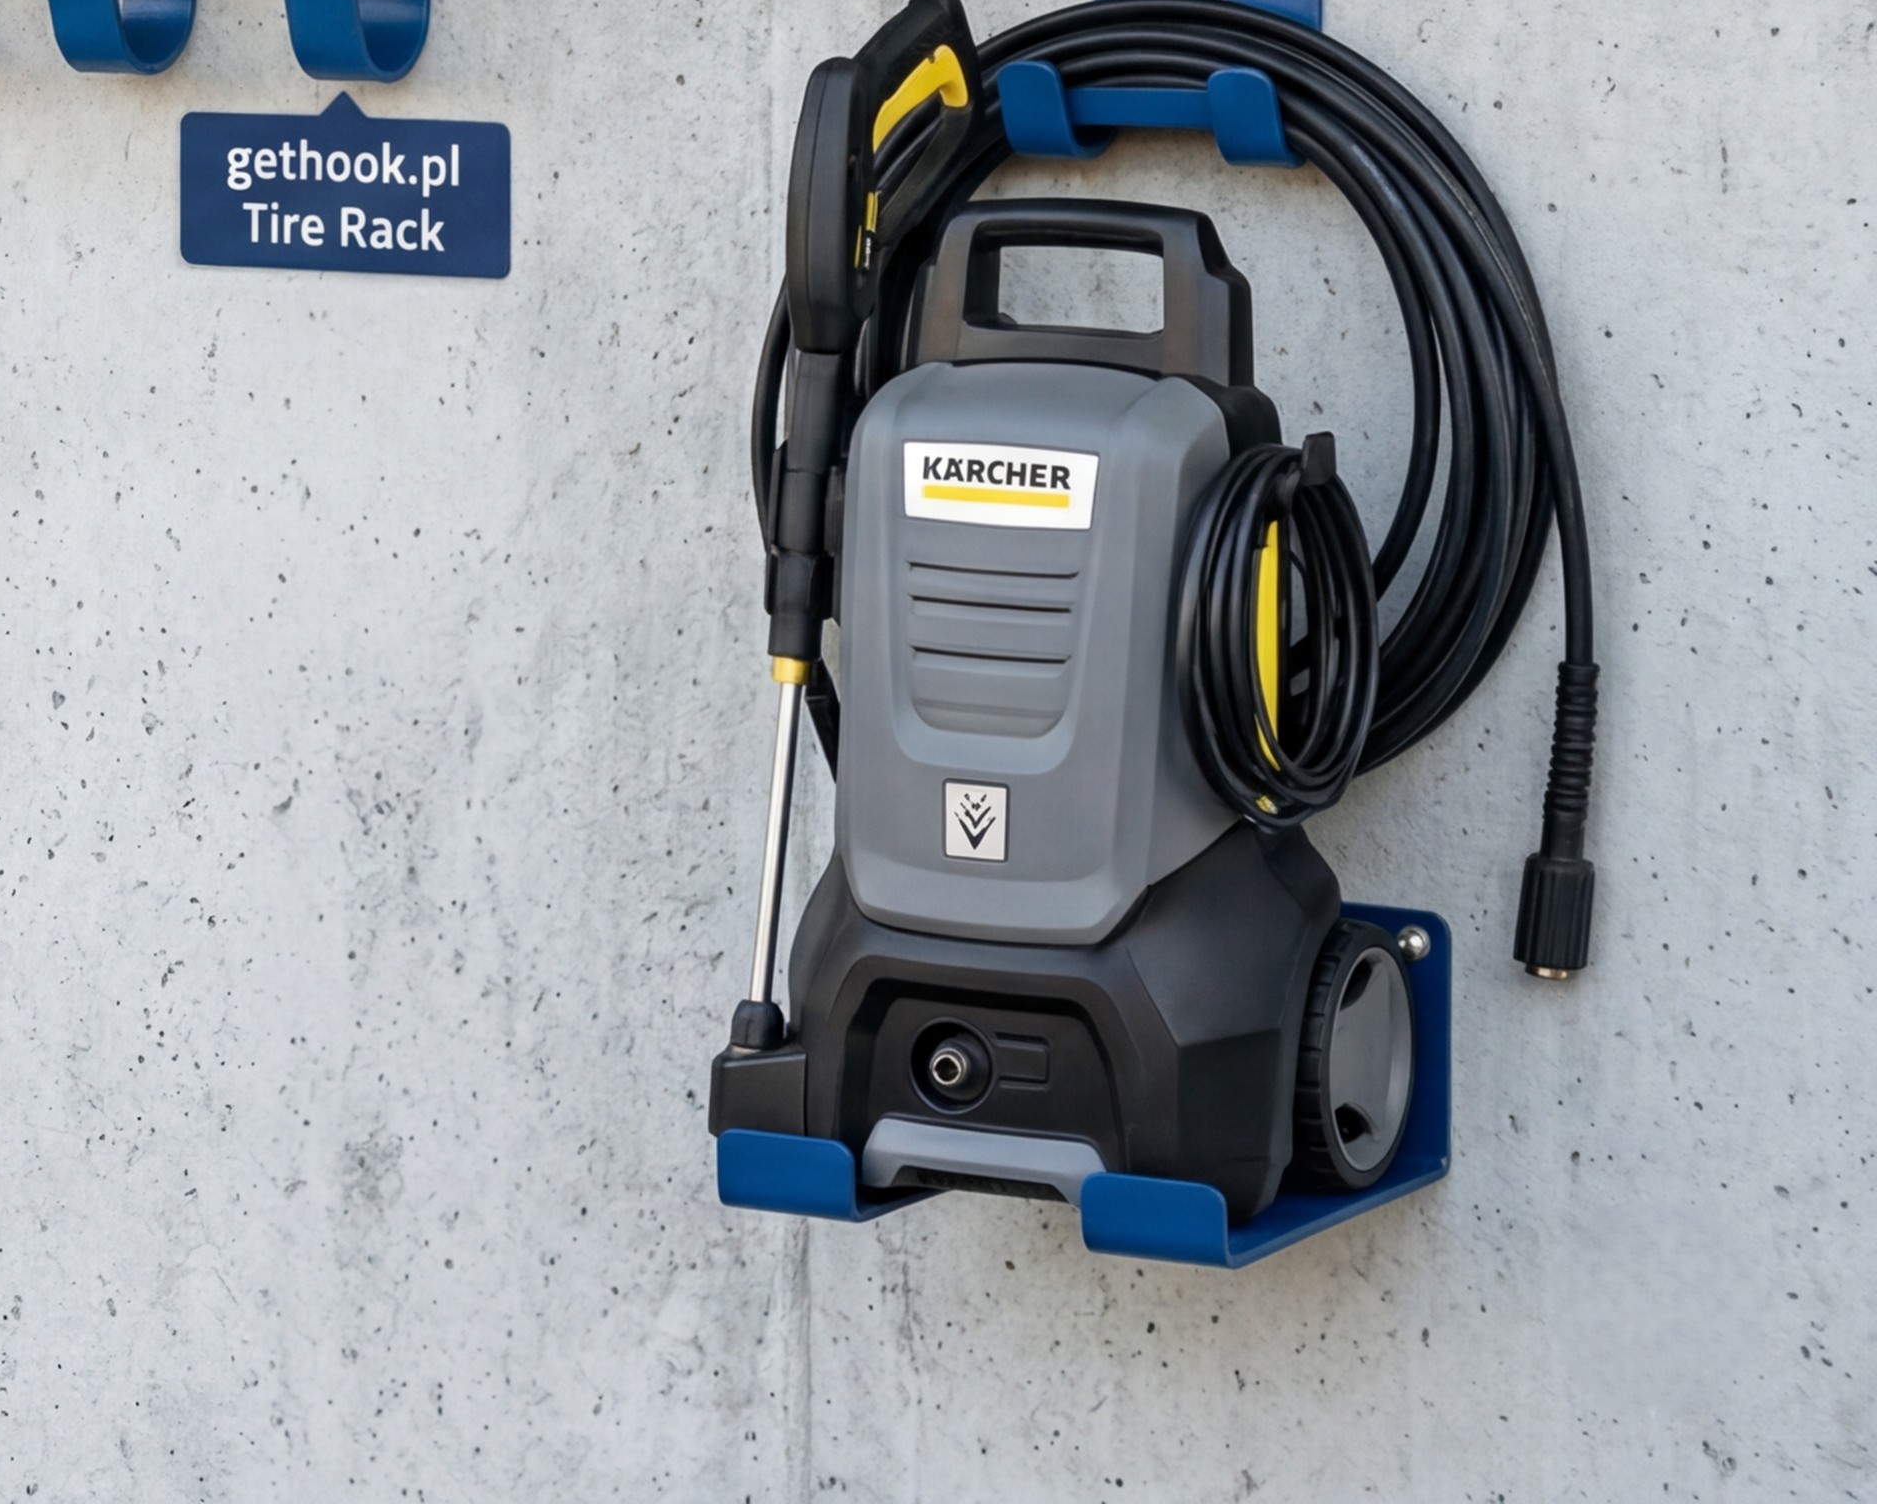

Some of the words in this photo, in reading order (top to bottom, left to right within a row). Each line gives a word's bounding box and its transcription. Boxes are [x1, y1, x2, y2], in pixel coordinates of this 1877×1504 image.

[226, 138, 460, 198] gethook.pl
[242, 201, 325, 247] Tire
[340, 206, 445, 252] Rack
[922, 454, 1071, 490] KÄRCHER
